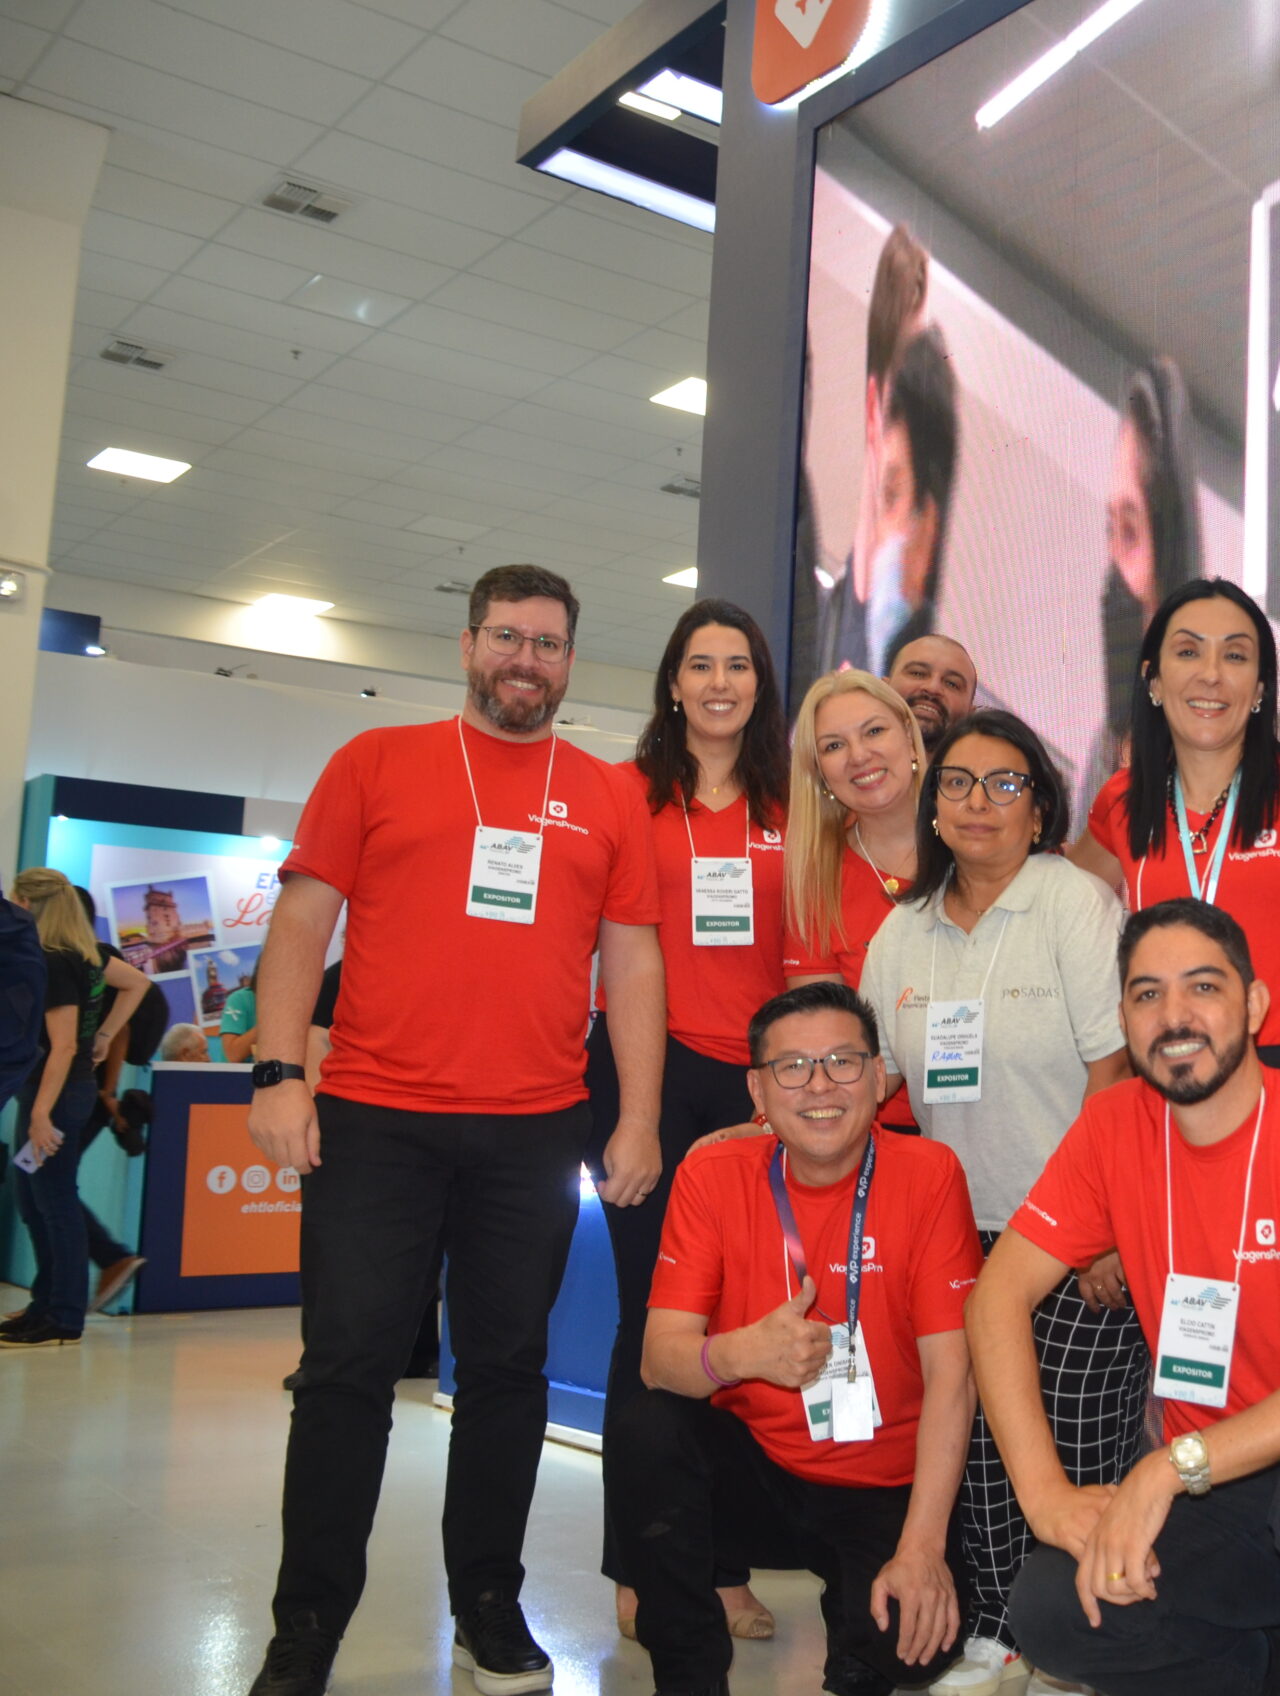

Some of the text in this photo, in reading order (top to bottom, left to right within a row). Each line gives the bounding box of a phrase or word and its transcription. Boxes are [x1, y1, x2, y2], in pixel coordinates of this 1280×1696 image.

[483, 892, 521, 904] EXPOSITOR
[1002, 987, 1060, 999] POSADAS
[937, 1074, 969, 1083] EXPOSITOR
[1182, 1297, 1207, 1307] ABAV
[1172, 1364, 1213, 1380] EXPOSITOR
